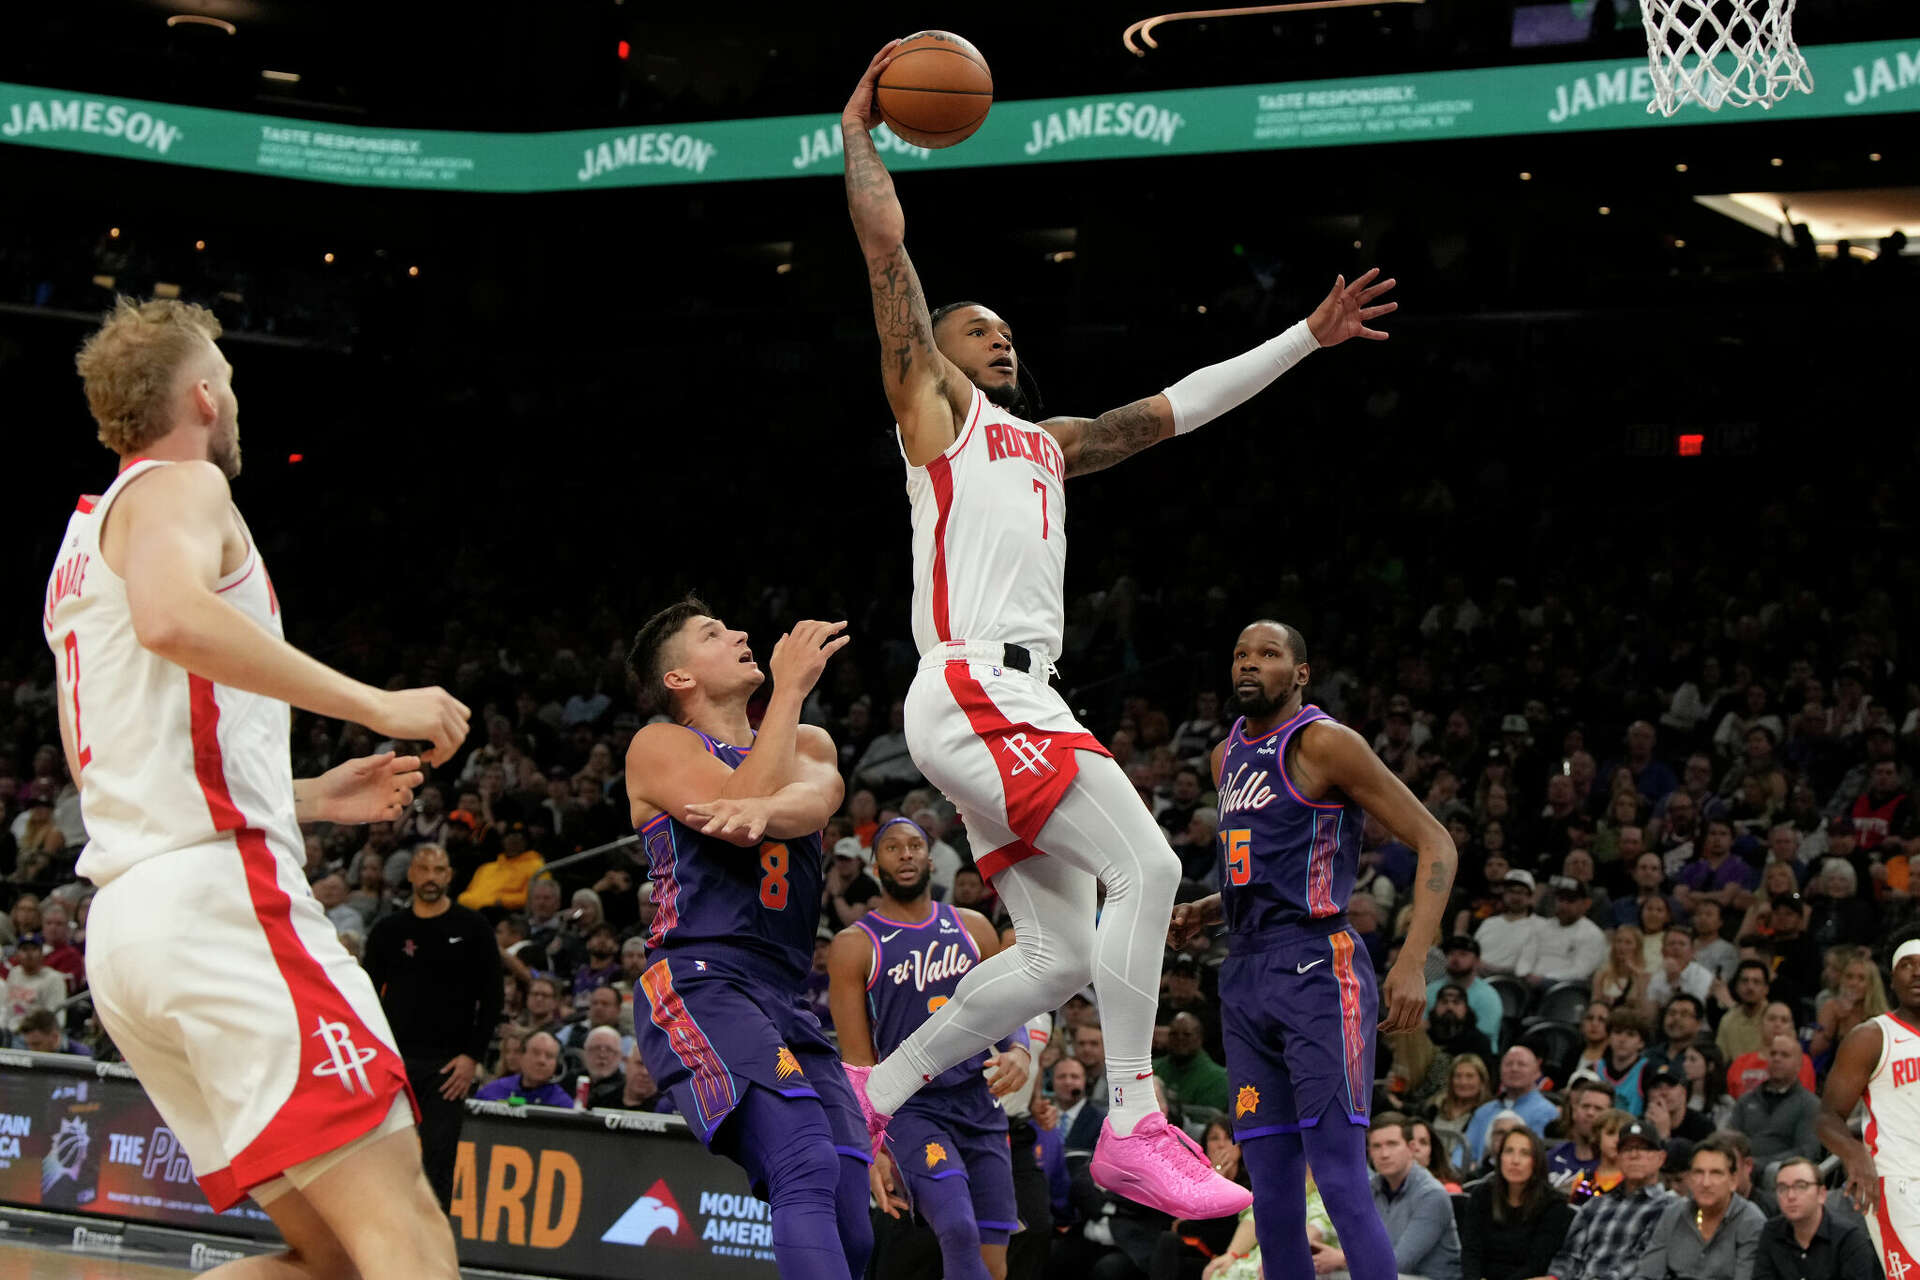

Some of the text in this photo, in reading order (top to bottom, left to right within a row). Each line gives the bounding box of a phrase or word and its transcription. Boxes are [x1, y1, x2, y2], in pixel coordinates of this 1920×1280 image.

[2, 99, 177, 155] JAMESON
[1024, 101, 1180, 155] JAMESON
[578, 131, 711, 182] JAMESON
[1032, 478, 1049, 541] 7
[1220, 761, 1278, 823] Valle
[759, 841, 790, 911] 8
[909, 940, 973, 992] Valle
[1891, 1057, 1920, 1089] RO
[108, 1133, 146, 1166] THE
[450, 1141, 583, 1249] ARD
